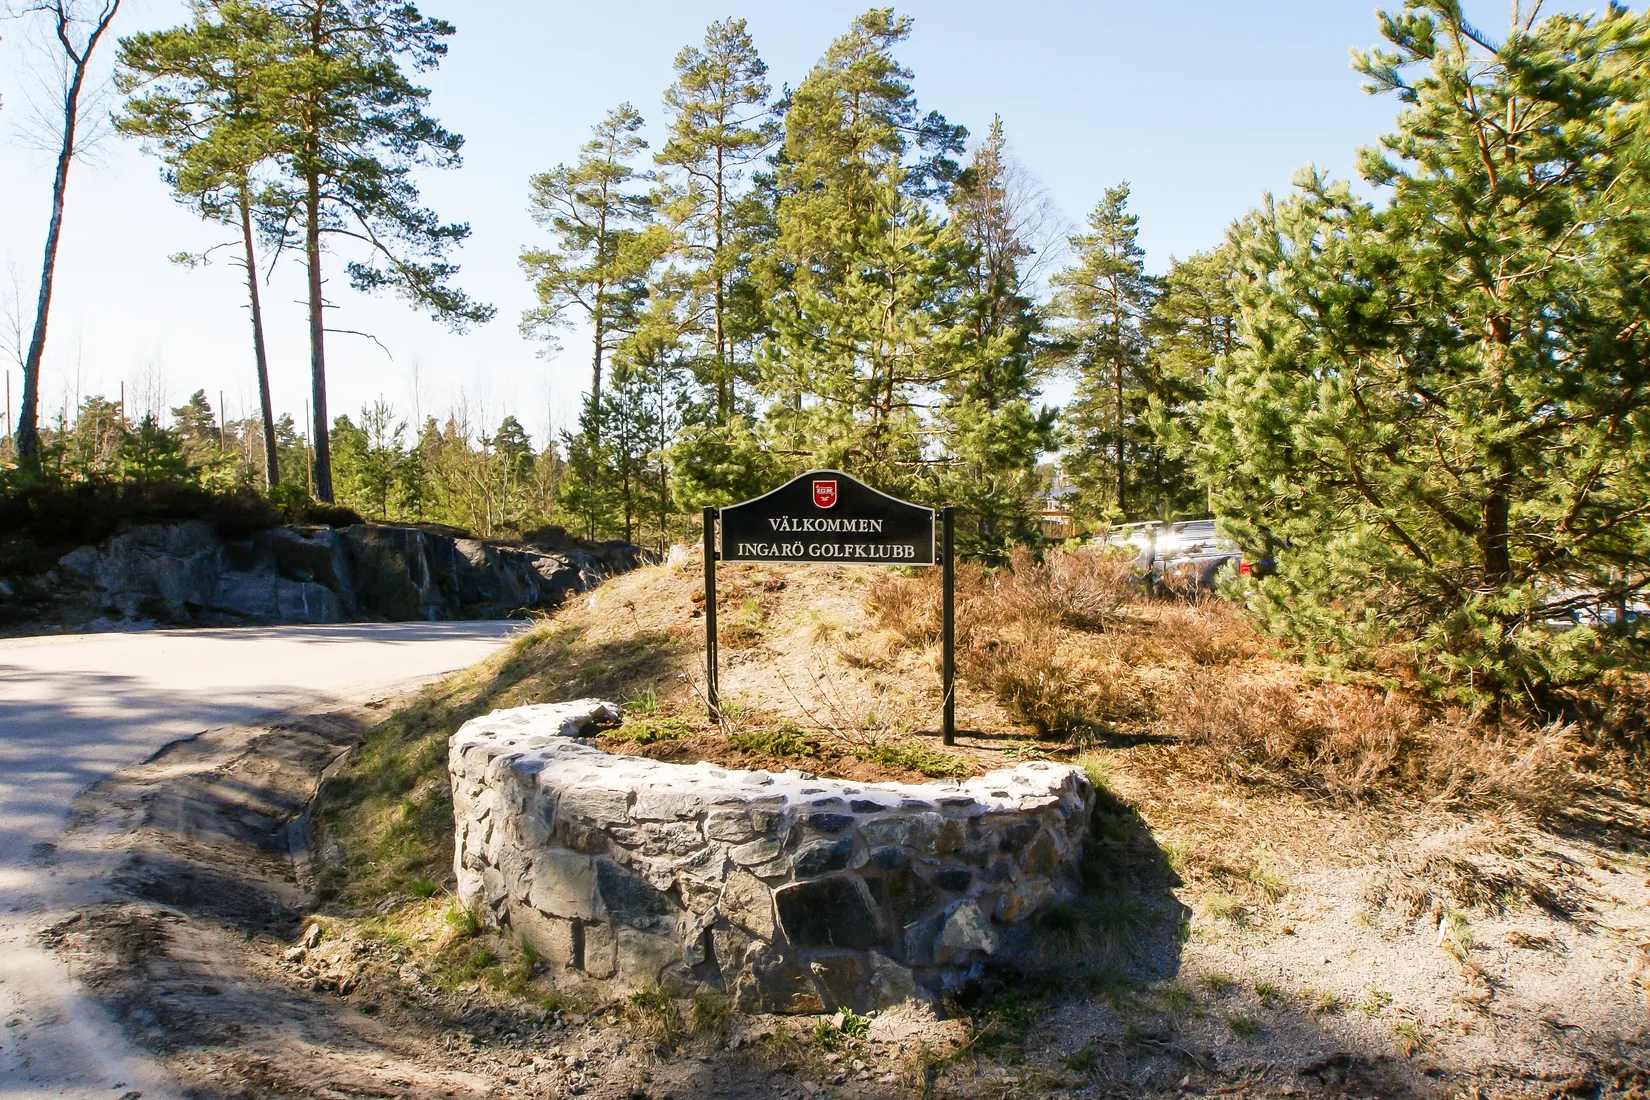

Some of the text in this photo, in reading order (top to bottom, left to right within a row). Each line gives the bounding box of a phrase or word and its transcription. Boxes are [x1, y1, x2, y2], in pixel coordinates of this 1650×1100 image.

[769, 515, 884, 532] VÄLKOMMEN
[738, 540, 915, 558] INGARÖ GOLFKLUBB
